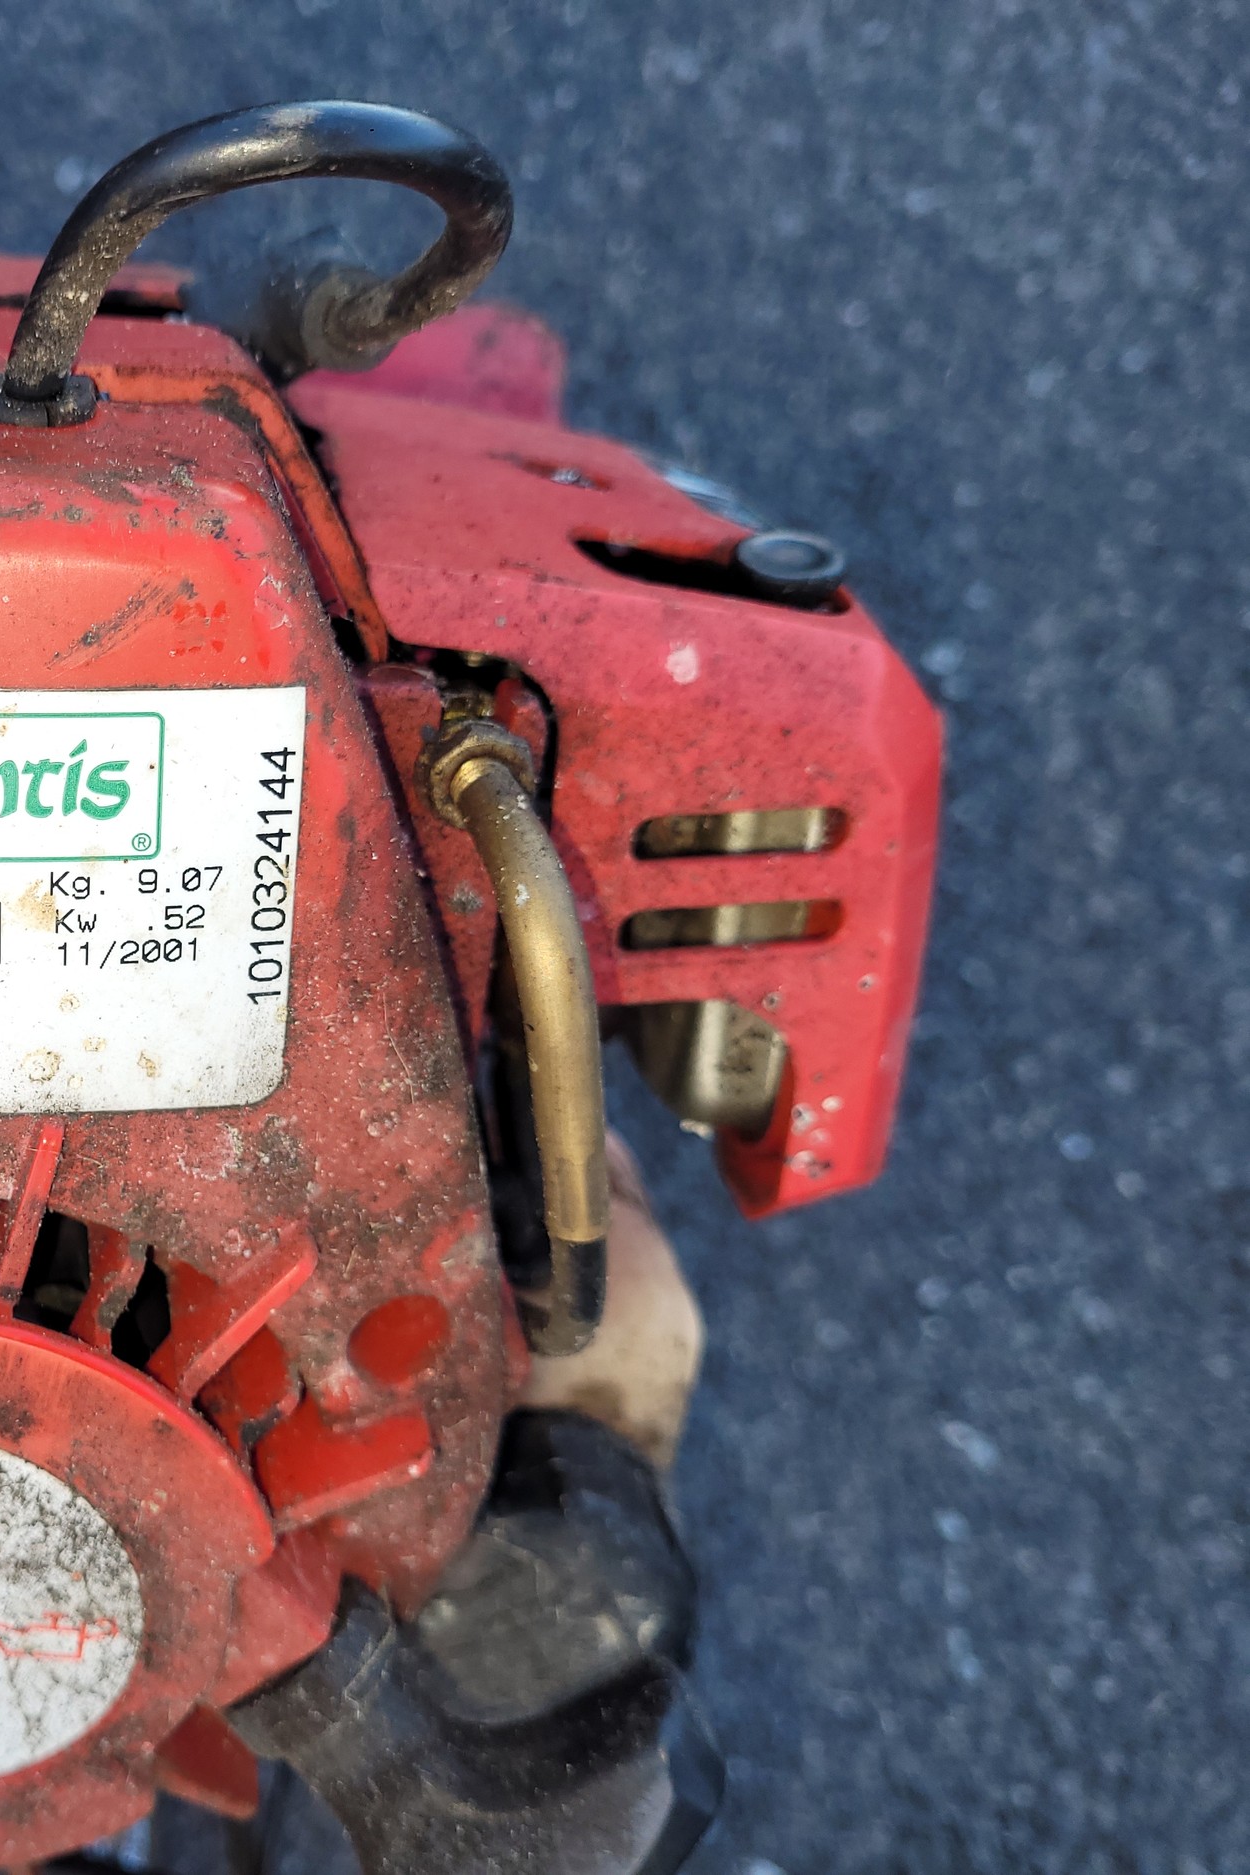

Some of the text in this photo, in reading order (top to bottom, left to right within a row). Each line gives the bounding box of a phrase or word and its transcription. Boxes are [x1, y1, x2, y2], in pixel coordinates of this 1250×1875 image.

[49, 866, 223, 898] Kg. 9.07
[247, 747, 296, 1005] 1010324144
[55, 905, 206, 934] Kw .52
[57, 938, 200, 969] 11/2001
